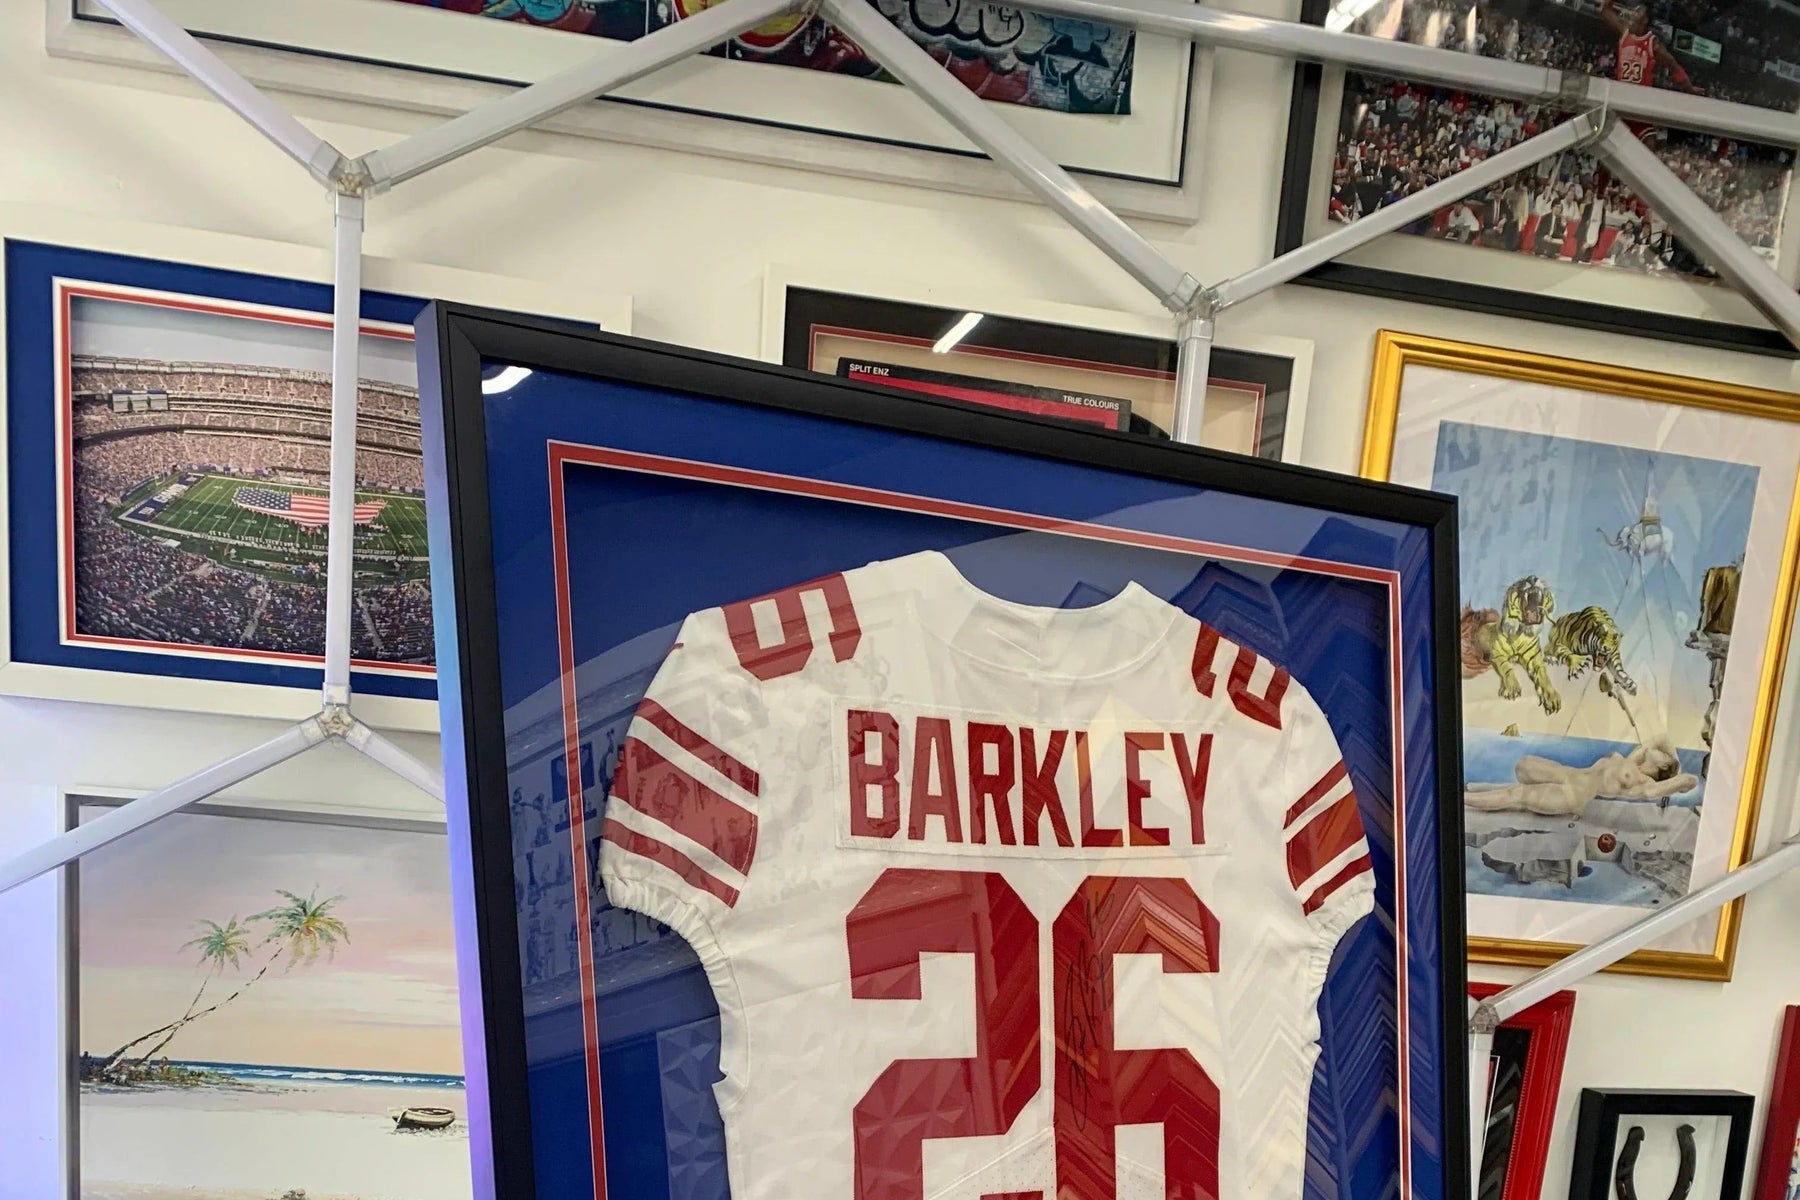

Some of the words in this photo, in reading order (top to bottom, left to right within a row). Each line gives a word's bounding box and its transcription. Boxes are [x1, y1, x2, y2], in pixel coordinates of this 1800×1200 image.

[849, 363, 872, 374] SPLIT
[873, 366, 889, 376] ENZ
[1063, 394, 1082, 405] TRUE
[1083, 397, 1119, 411] COLOURS
[846, 708, 1214, 848] BARKLEY
